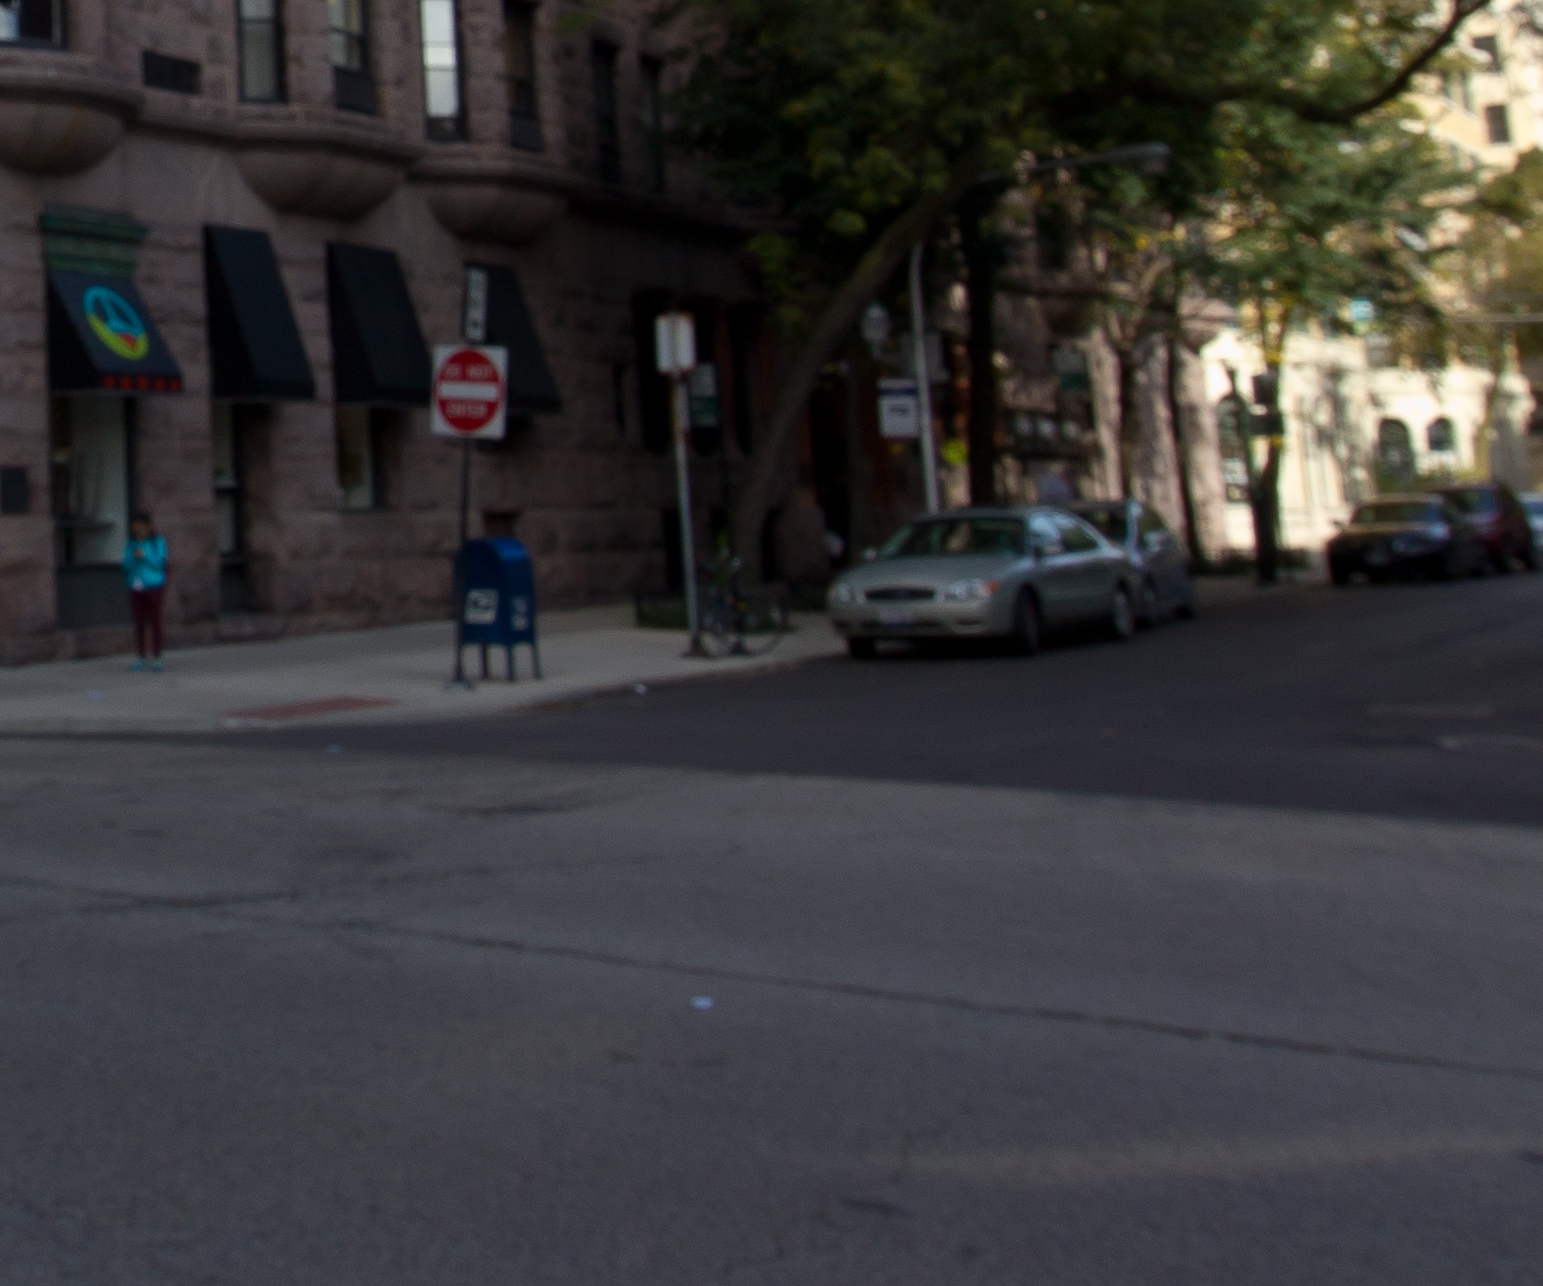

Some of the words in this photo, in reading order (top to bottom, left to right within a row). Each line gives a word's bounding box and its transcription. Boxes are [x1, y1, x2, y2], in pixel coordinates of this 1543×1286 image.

[444, 364, 462, 379] DO
[467, 364, 492, 380] NOT
[448, 403, 488, 419] ENTER
